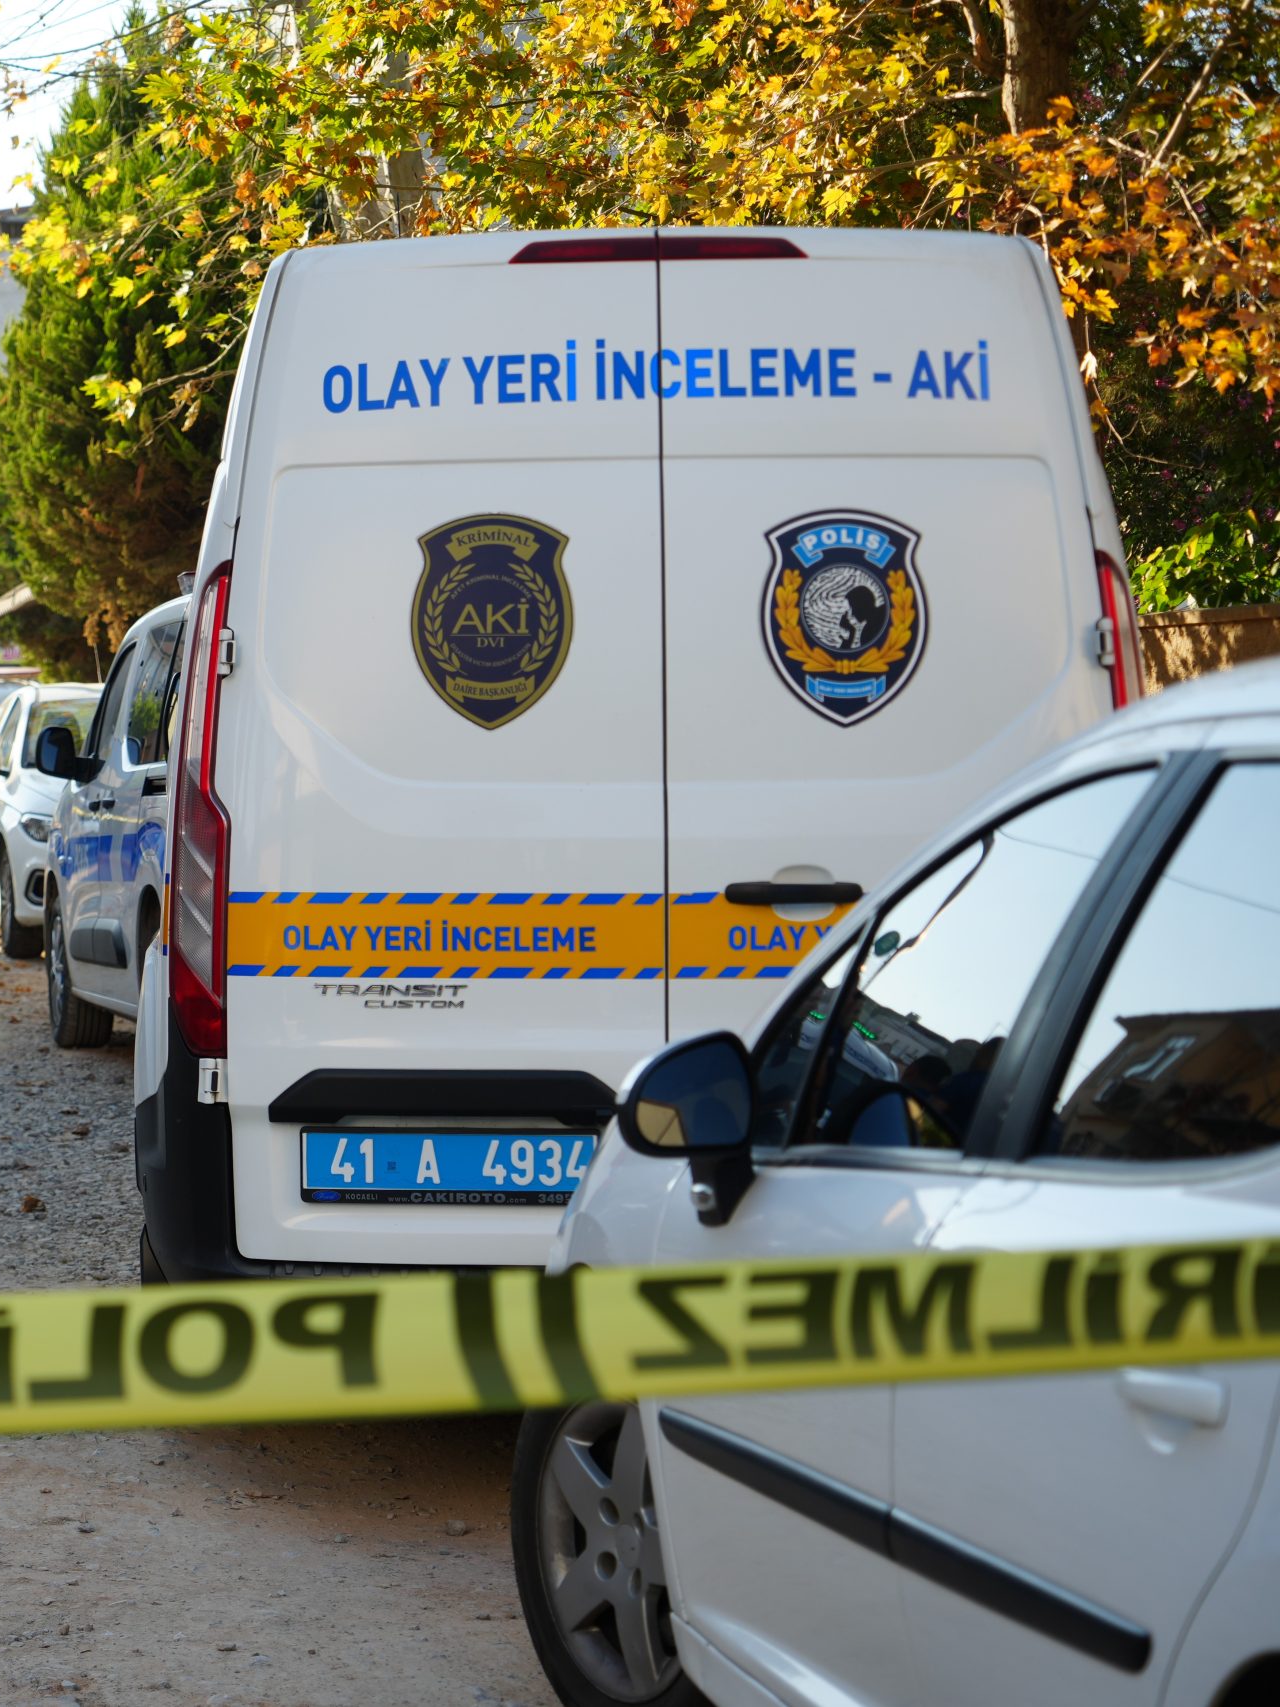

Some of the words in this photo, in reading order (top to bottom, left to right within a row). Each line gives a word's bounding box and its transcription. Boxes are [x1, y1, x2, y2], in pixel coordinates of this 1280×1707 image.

[323, 358, 451, 413] OLAY
[463, 339, 578, 404] YERİ
[595, 339, 857, 399] İNCELEME
[907, 340, 991, 400] AKİ
[456, 528, 531, 548] KRİMİNAL
[803, 527, 882, 551] POLİS
[451, 598, 530, 635] AKİ
[476, 637, 505, 648] DVI
[283, 925, 358, 951] OLAY
[365, 920, 432, 951] YERİ
[441, 920, 596, 952] İNCELEME
[728, 925, 807, 951] OLAY
[314, 984, 468, 997] TRANSIT
[364, 1000, 465, 1009] CUSTOM
[330, 1137, 374, 1183] 41
[416, 1139, 441, 1184] A
[482, 1139, 588, 1186] 4934
